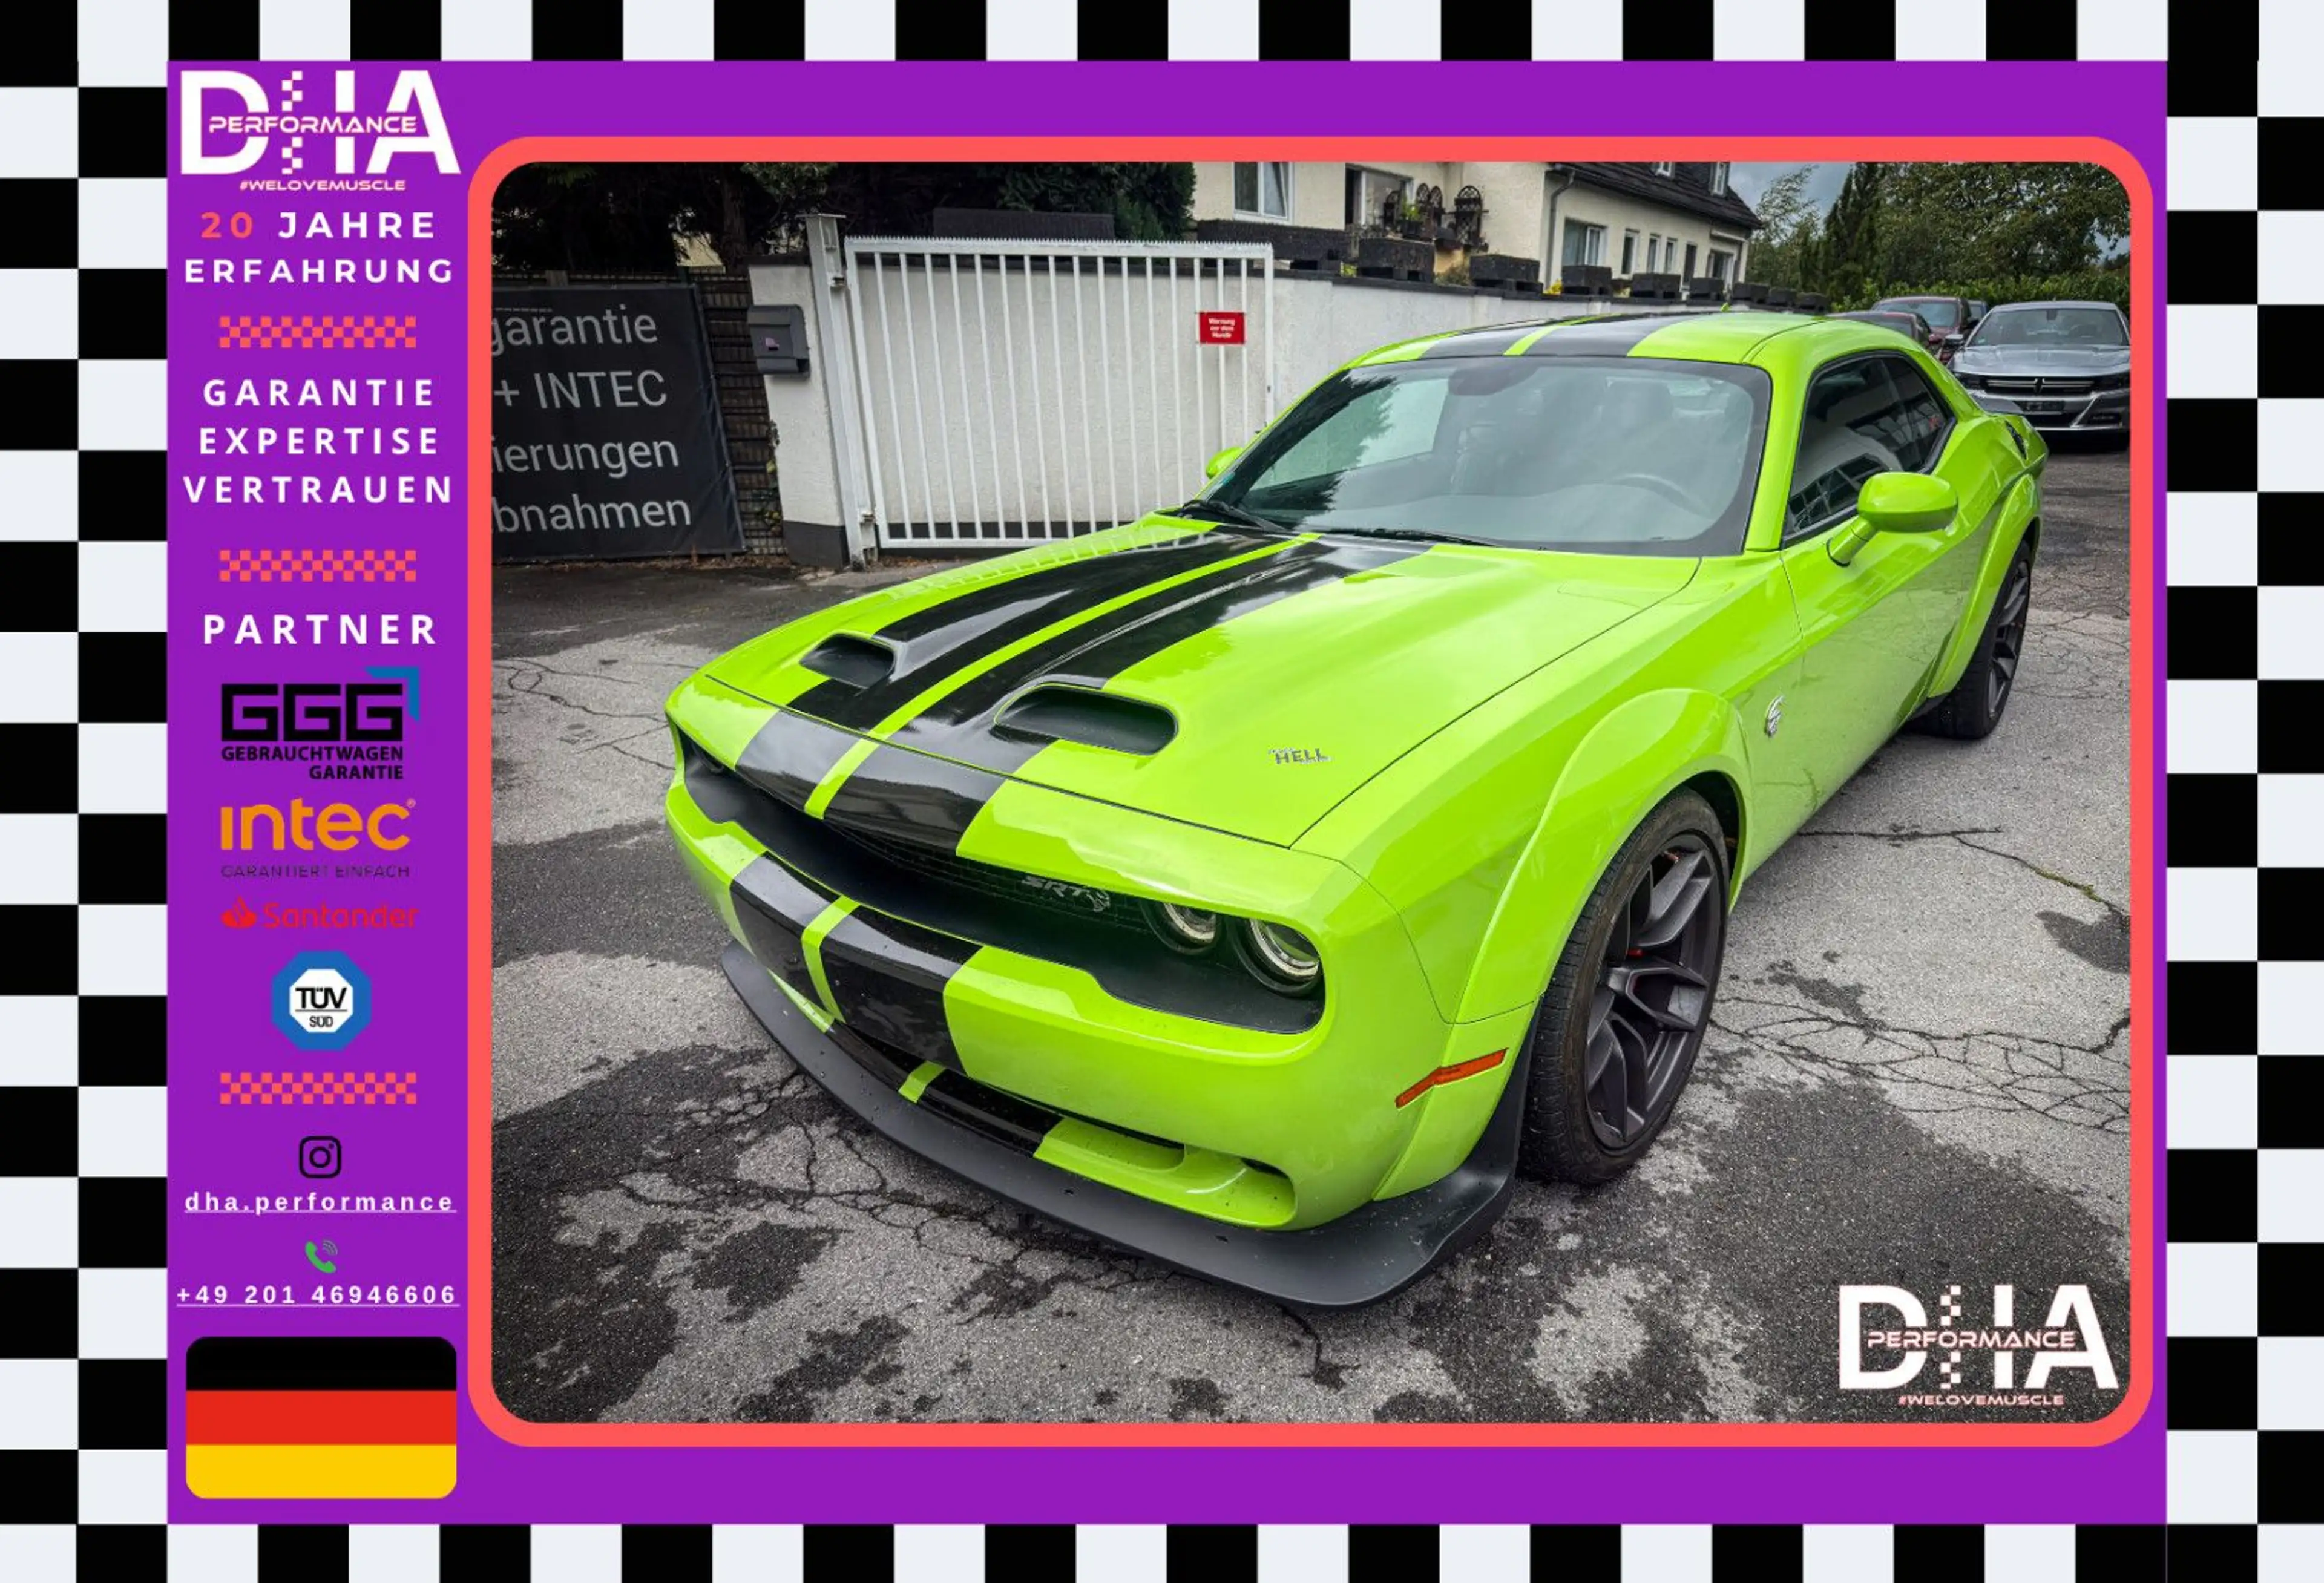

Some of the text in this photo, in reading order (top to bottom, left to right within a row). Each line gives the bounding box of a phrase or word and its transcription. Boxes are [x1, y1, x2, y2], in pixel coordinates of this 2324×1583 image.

[494, 370, 667, 409] + INTEC
[1275, 748, 1331, 765] HELL
[1021, 876, 1090, 898] SRT
